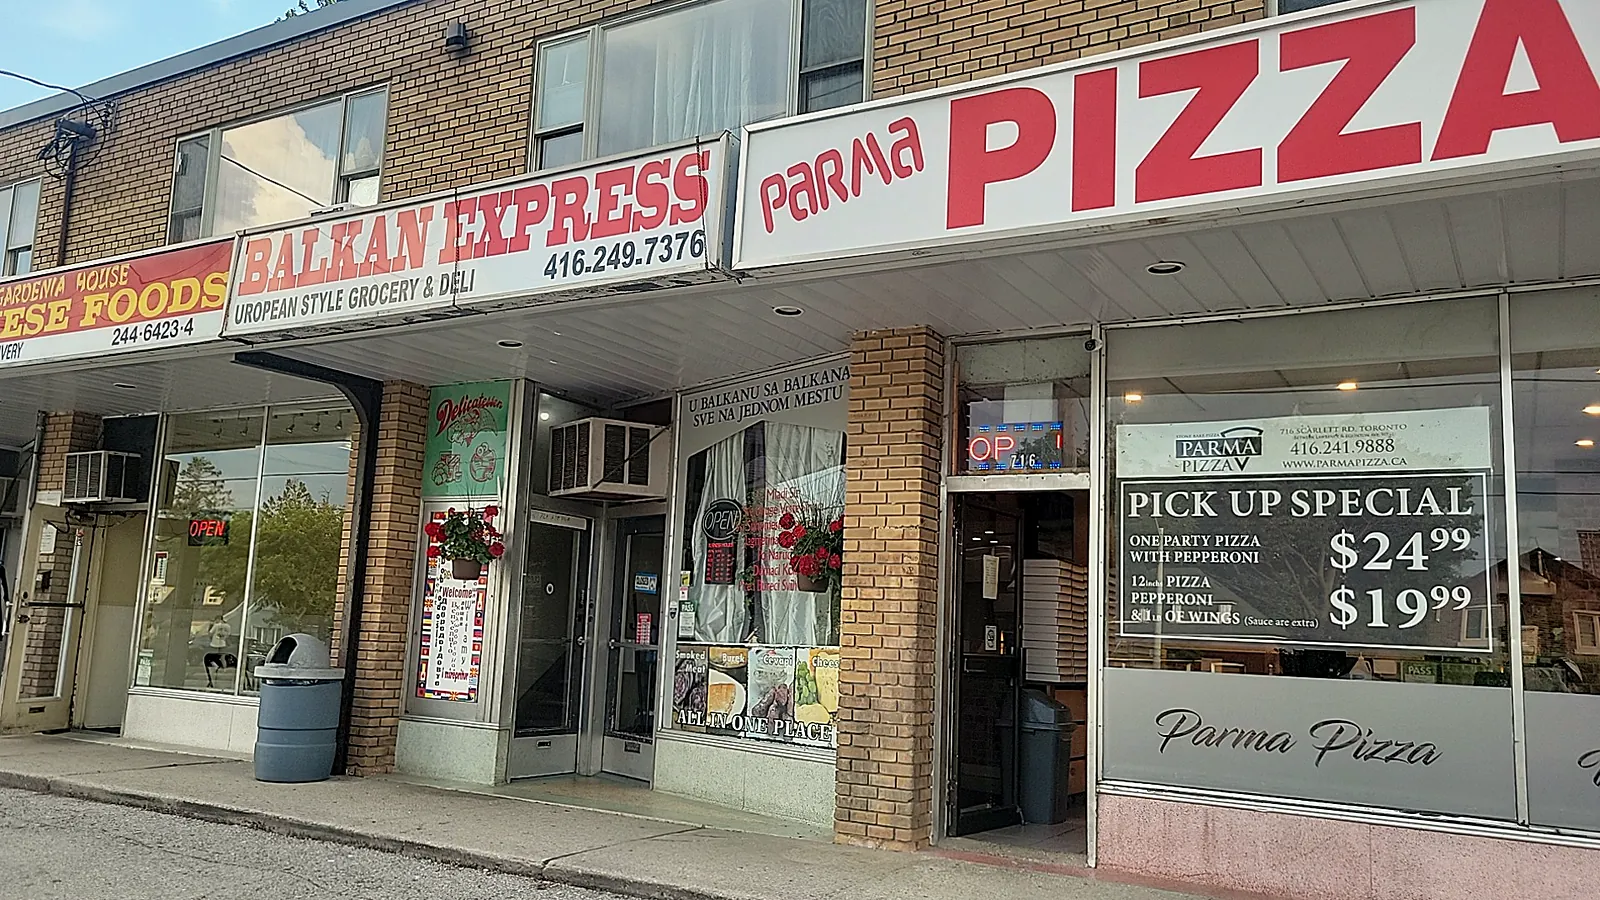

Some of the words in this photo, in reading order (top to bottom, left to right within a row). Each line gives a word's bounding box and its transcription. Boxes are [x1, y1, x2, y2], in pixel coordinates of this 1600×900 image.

[947, 0, 1600, 230] PIZZA
[238, 204, 434, 296] BALKAN
[438, 151, 710, 264] EXPRESS
[544, 229, 705, 280] 416.249.7376
[76, 264, 131, 292] HOUSE
[0, 298, 72, 338] ESE
[80, 271, 228, 327] FOODS
[235, 299, 297, 325] UROPEAN
[301, 288, 342, 314] STYLE
[349, 277, 420, 308] GROCERY
[423, 274, 435, 299] &
[440, 268, 476, 296] DELI
[0, 342, 24, 360] VERY
[689, 400, 699, 412] U
[700, 385, 760, 410] BALKANU
[764, 381, 778, 397] SA
[783, 365, 850, 393] BALKANA
[693, 413, 715, 427] SVE
[718, 408, 735, 423] NA
[737, 398, 790, 423] JEDNOM
[794, 384, 844, 408] MESTU
[1296, 426, 1339, 434] SCARLETT
[1360, 424, 1407, 432] TORONTO
[1181, 439, 1259, 457] PARMA
[1290, 438, 1395, 456] 416.241.9888
[1010, 454, 1036, 469] 716
[1182, 458, 1235, 472] PIZZA
[1282, 457, 1408, 468] WWW.PARMAPIZZA.CA
[1128, 490, 1218, 518] PICK
[1229, 490, 1281, 517] UP
[1290, 487, 1473, 517] SPECIAL
[188, 519, 226, 537] OPEN
[704, 510, 736, 530] OPEN
[1129, 535, 1160, 547] ONE
[1163, 535, 1213, 547] PARTY
[1215, 535, 1261, 547] PIZZA
[1130, 551, 1169, 563] WITH
[1174, 551, 1259, 563] PEPPERONI
[1166, 576, 1211, 588] PIZZA
[443, 586, 472, 599] Welcome
[1131, 593, 1213, 606] PEPPERONI
[1131, 609, 1142, 621] &
[1165, 611, 1186, 622] OF
[1189, 612, 1240, 625] WINGS
[1244, 616, 1273, 627] (Sauce
[1275, 619, 1289, 627] are
[1291, 618, 1319, 628] extra)
[675, 650, 706, 660] Smoked
[722, 653, 746, 664] Burek
[763, 655, 794, 667] Cevapi
[812, 656, 839, 668] Chees
[685, 664, 706, 674] Meat
[1408, 666, 1432, 675] PASS
[677, 709, 705, 726] ALL
[709, 712, 727, 729] IN
[732, 715, 768, 734] ONE
[773, 719, 833, 741] PLACE
[1155, 708, 1297, 754] Parma
[1309, 719, 1443, 767] Pizza
